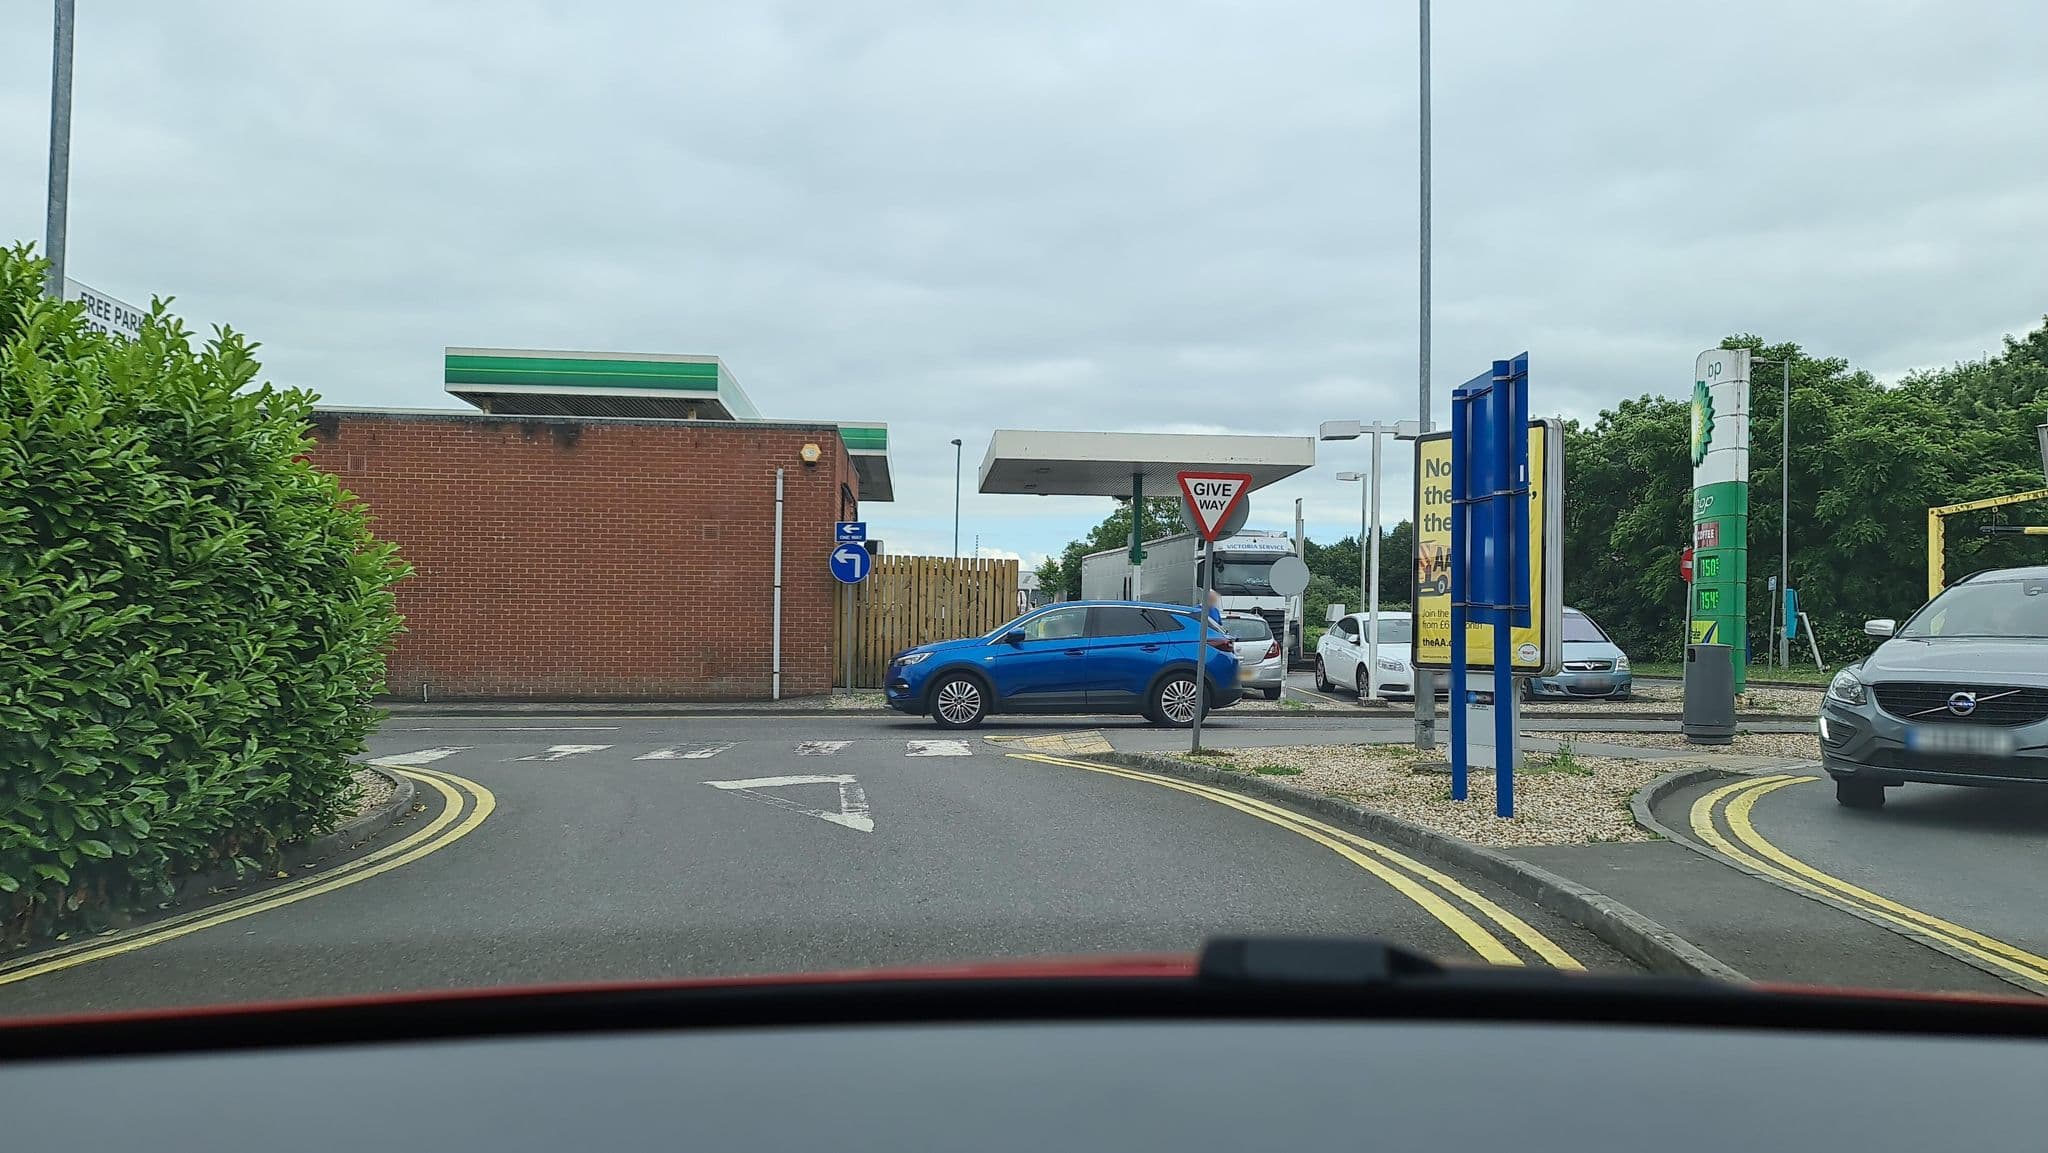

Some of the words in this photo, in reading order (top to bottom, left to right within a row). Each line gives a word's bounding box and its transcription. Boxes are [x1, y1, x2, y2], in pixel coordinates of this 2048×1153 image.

[81, 292, 111, 321] FREE
[1708, 361, 1722, 381] bp
[1193, 482, 1233, 497] GIVE
[1199, 500, 1226, 511] WAY
[1423, 609, 1435, 618] Join
[1437, 609, 1449, 618] the
[1423, 620, 1438, 630] from
